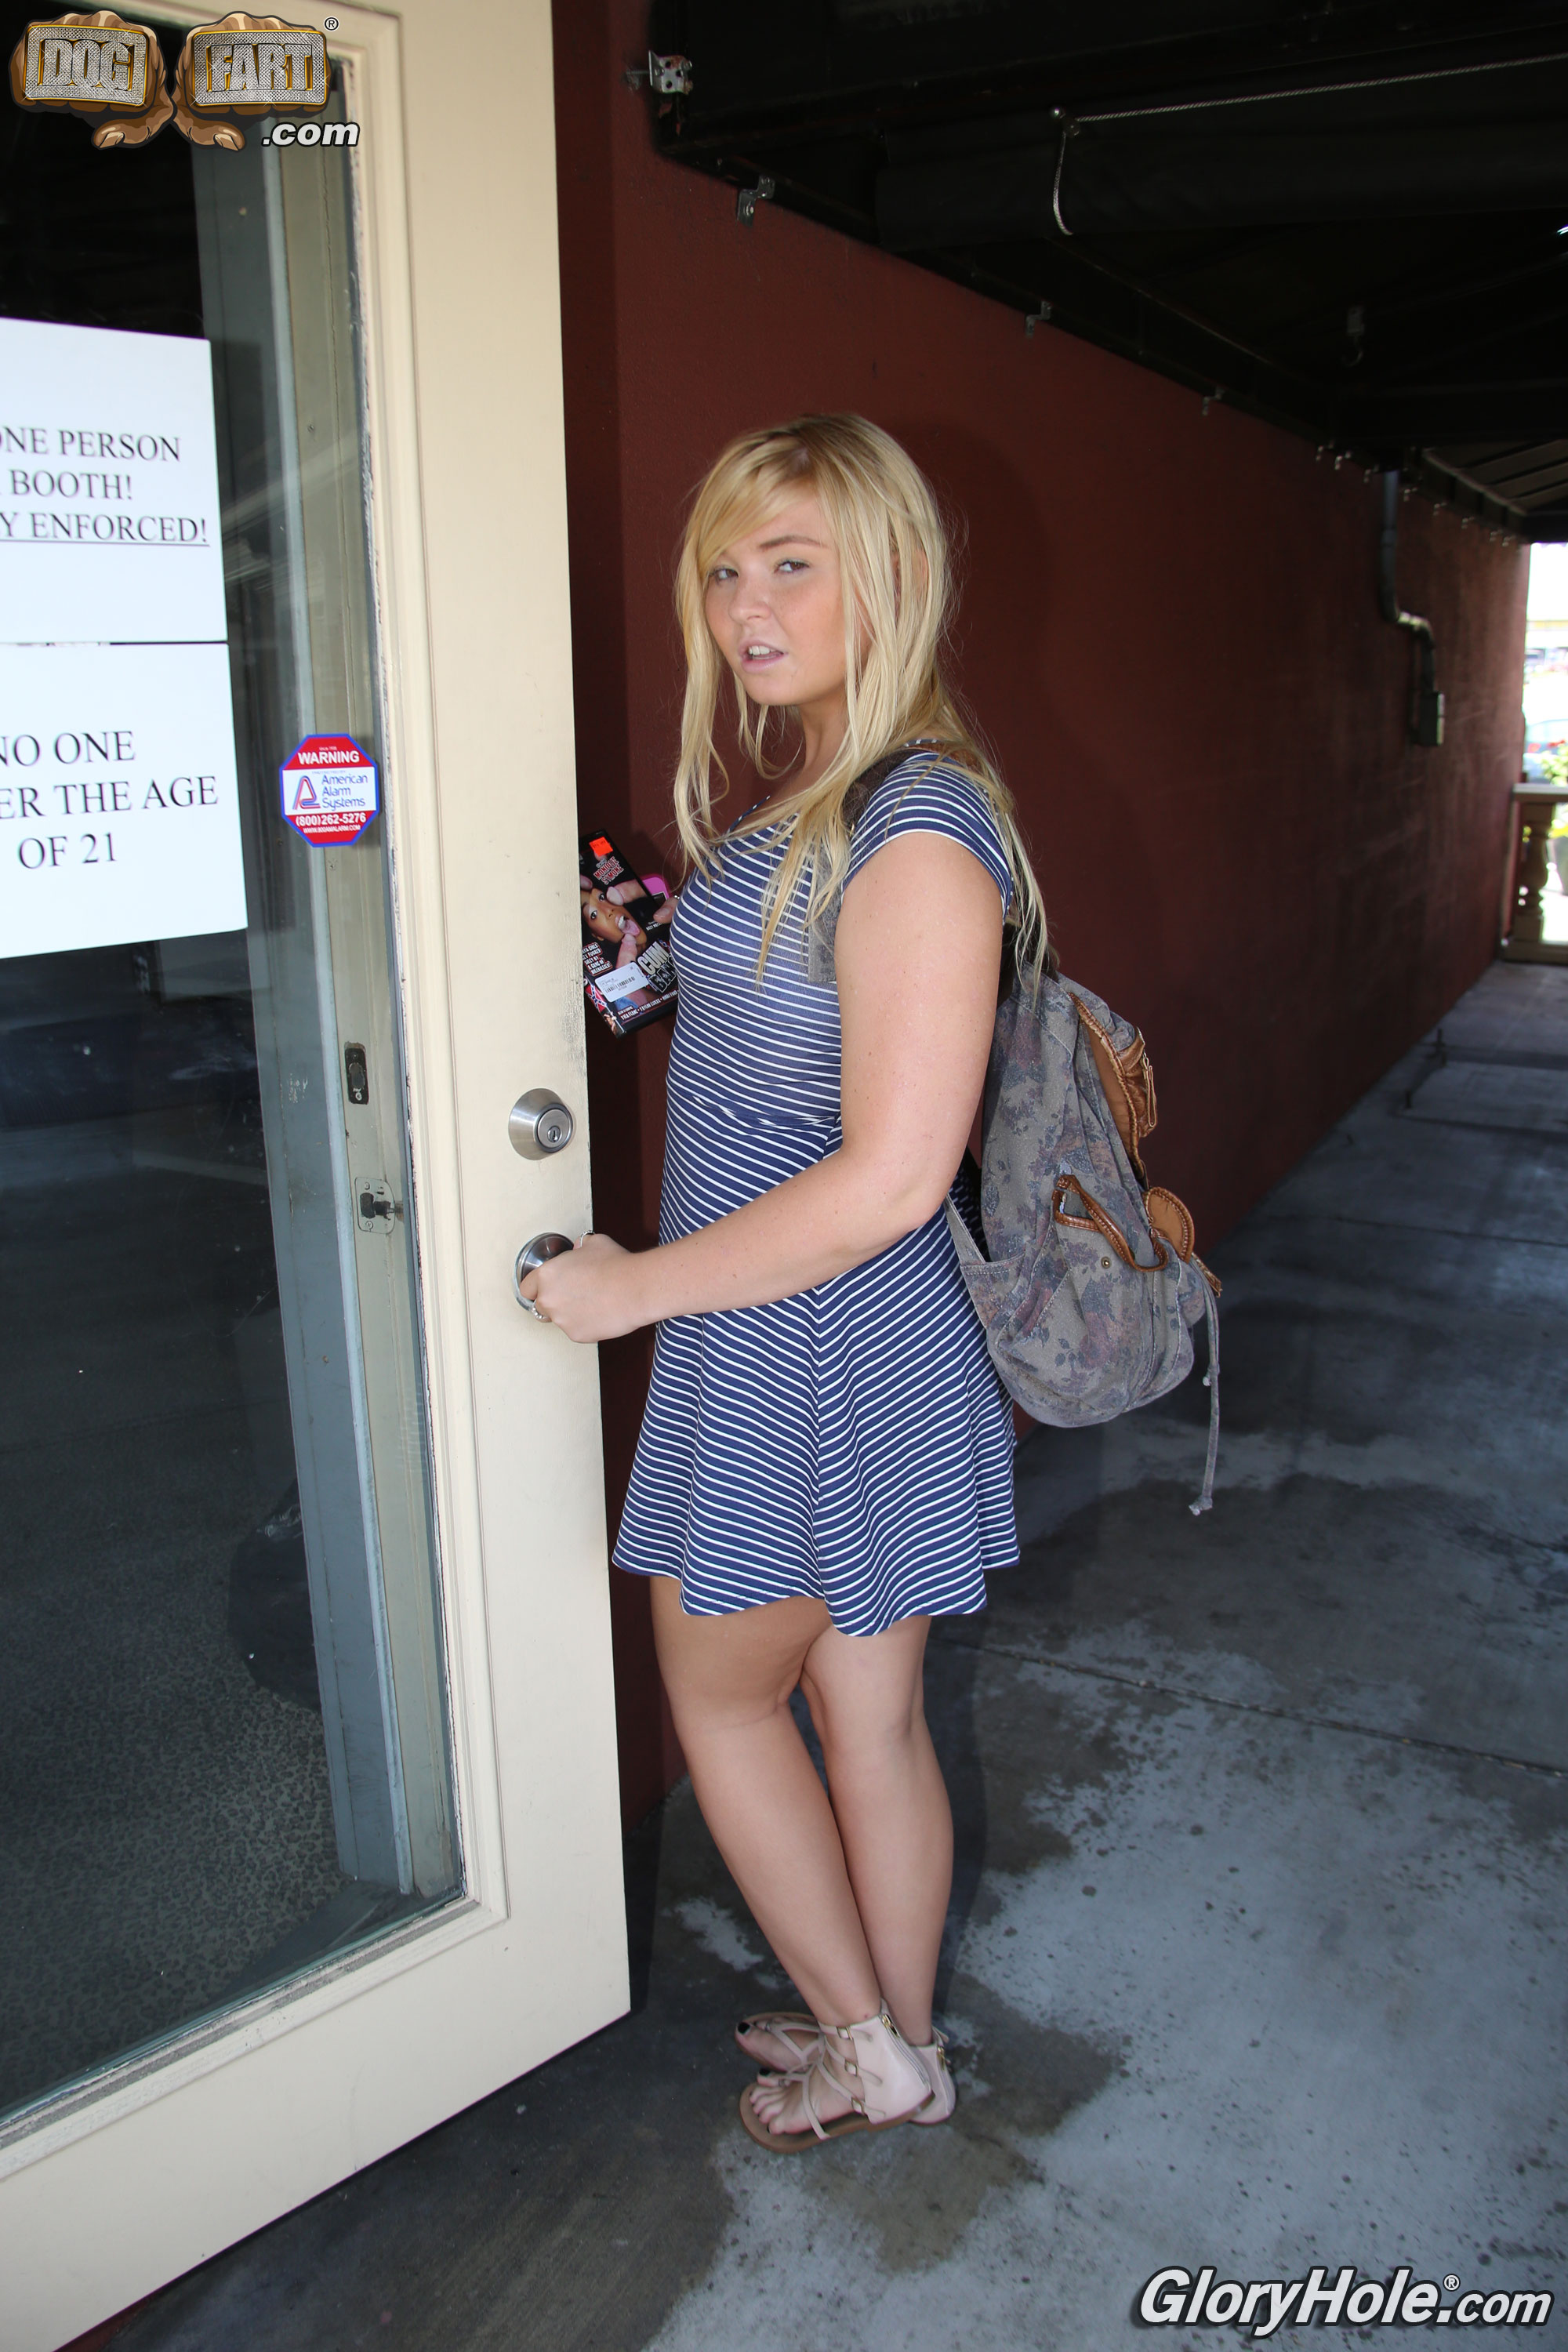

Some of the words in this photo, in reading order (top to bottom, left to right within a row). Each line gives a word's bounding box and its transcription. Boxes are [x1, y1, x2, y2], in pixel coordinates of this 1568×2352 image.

[0, 426, 49, 455] NE
[58, 430, 180, 462] PERSON
[9, 469, 132, 500] BOOTH!
[30, 512, 208, 543] ENFORCED!
[53, 731, 136, 765] ONE
[298, 750, 360, 764] WARNING
[322, 773, 368, 785] American
[322, 786, 350, 797] Alarm
[54, 781, 132, 815] THE
[142, 776, 219, 809] AGE
[322, 797, 365, 811] Systems
[18, 836, 68, 869] OF
[81, 833, 117, 864] 21
[593, 856, 619, 880] MONIQUE
[601, 864, 624, 884] SYMONE
[637, 941, 670, 975] CUM
